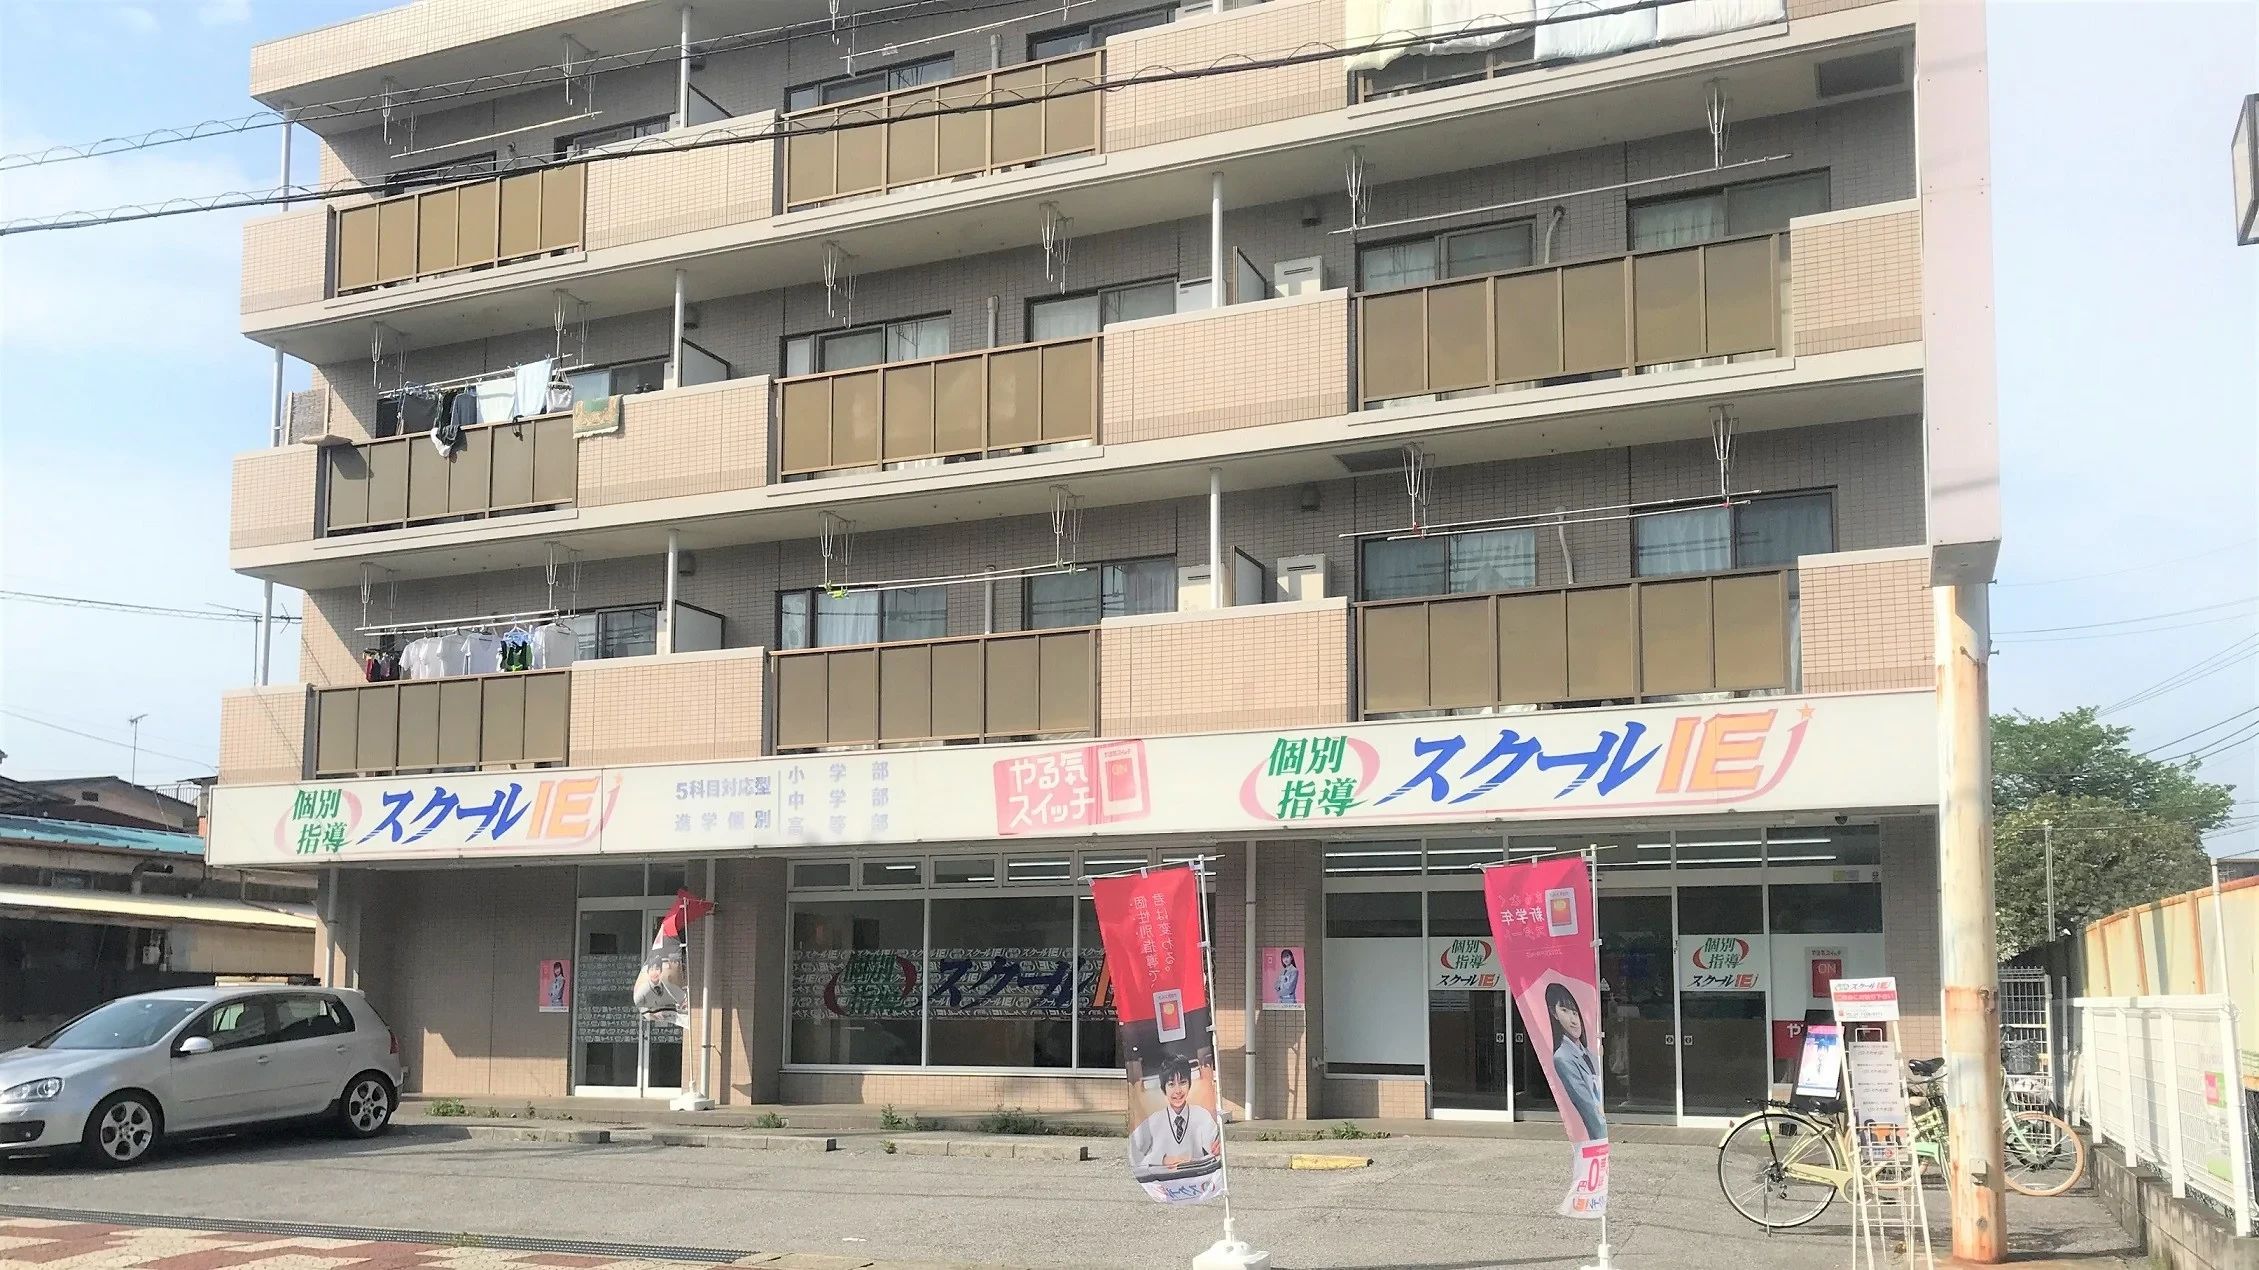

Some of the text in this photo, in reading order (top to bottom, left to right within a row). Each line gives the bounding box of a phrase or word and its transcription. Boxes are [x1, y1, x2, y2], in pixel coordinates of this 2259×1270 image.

[1268, 736, 1346, 777] 個別
[1373, 708, 1778, 805] スクールIE
[788, 760, 889, 785] 小学部
[1009, 751, 1088, 793] やる気
[675, 776, 771, 800] 5科目対応型
[788, 788, 889, 809] 中学部
[1278, 776, 1366, 820] 指導
[293, 788, 342, 820] 個別
[355, 776, 600, 845] スクールIE
[1008, 786, 1095, 829] スイッチ
[674, 810, 771, 832] 進学個別
[788, 813, 889, 835] 高等部
[296, 822, 346, 855] 指導
[1451, 939, 1480, 954] 個別
[1704, 937, 1736, 953] 個別
[1455, 954, 1484, 970] 指導
[1708, 953, 1740, 969] 指導
[1818, 963, 1837, 975] ON
[1436, 972, 1496, 988] スクールIE
[1687, 973, 1754, 989] スクールIE
